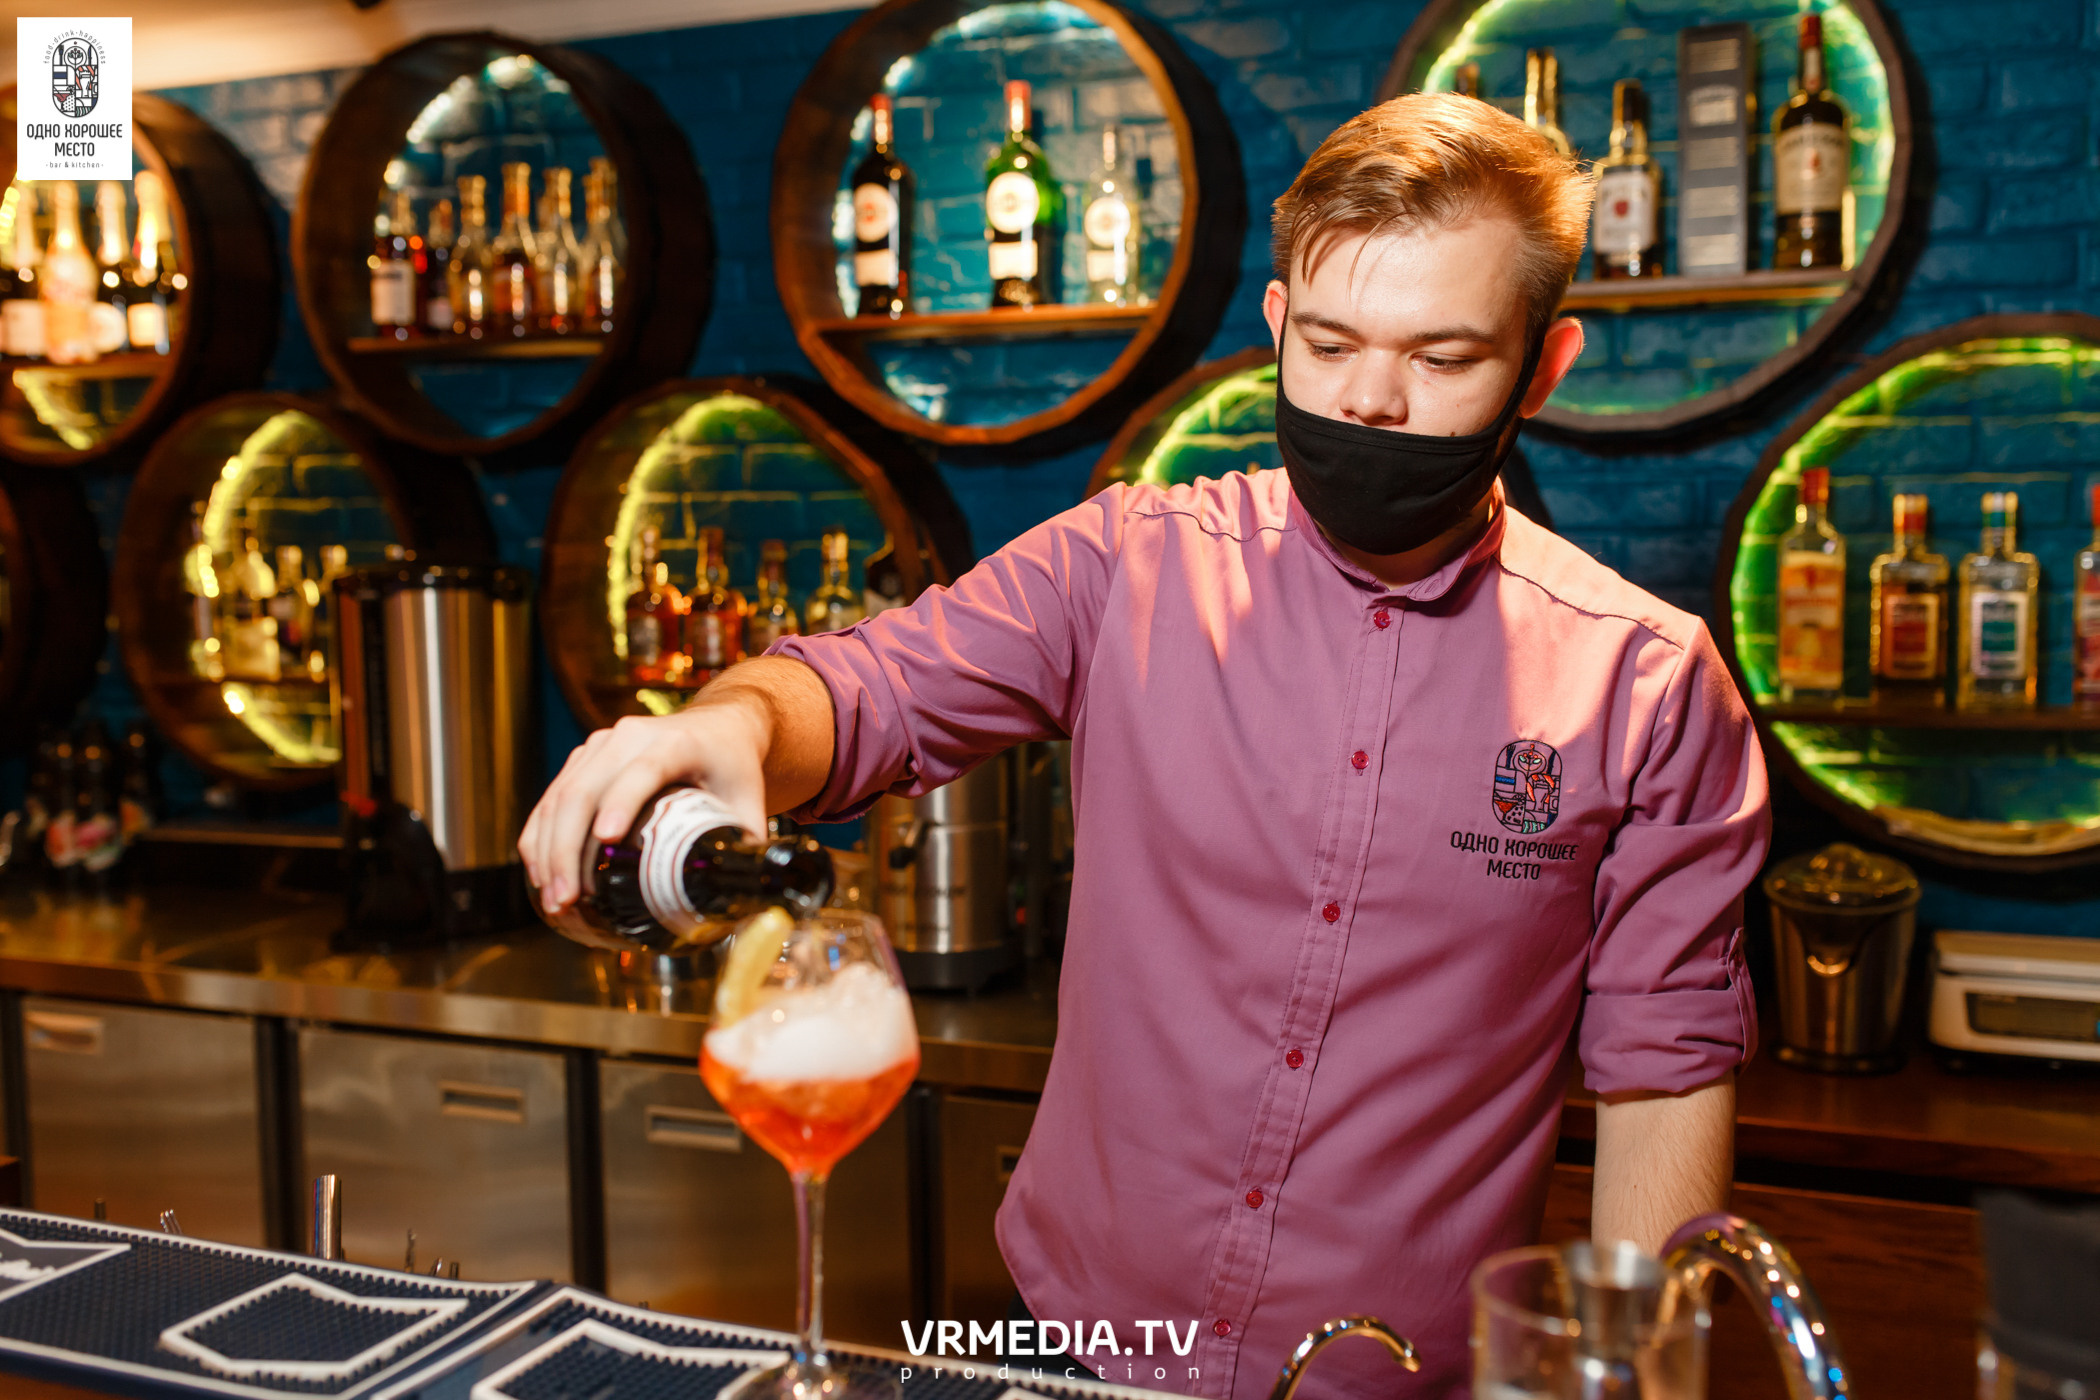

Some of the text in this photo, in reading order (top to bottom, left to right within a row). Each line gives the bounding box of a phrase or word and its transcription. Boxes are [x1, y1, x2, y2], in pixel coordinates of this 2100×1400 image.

[1451, 831, 1579, 860] ОДНО ХОРОШЕЕ
[1487, 859, 1541, 880] МЕСТО
